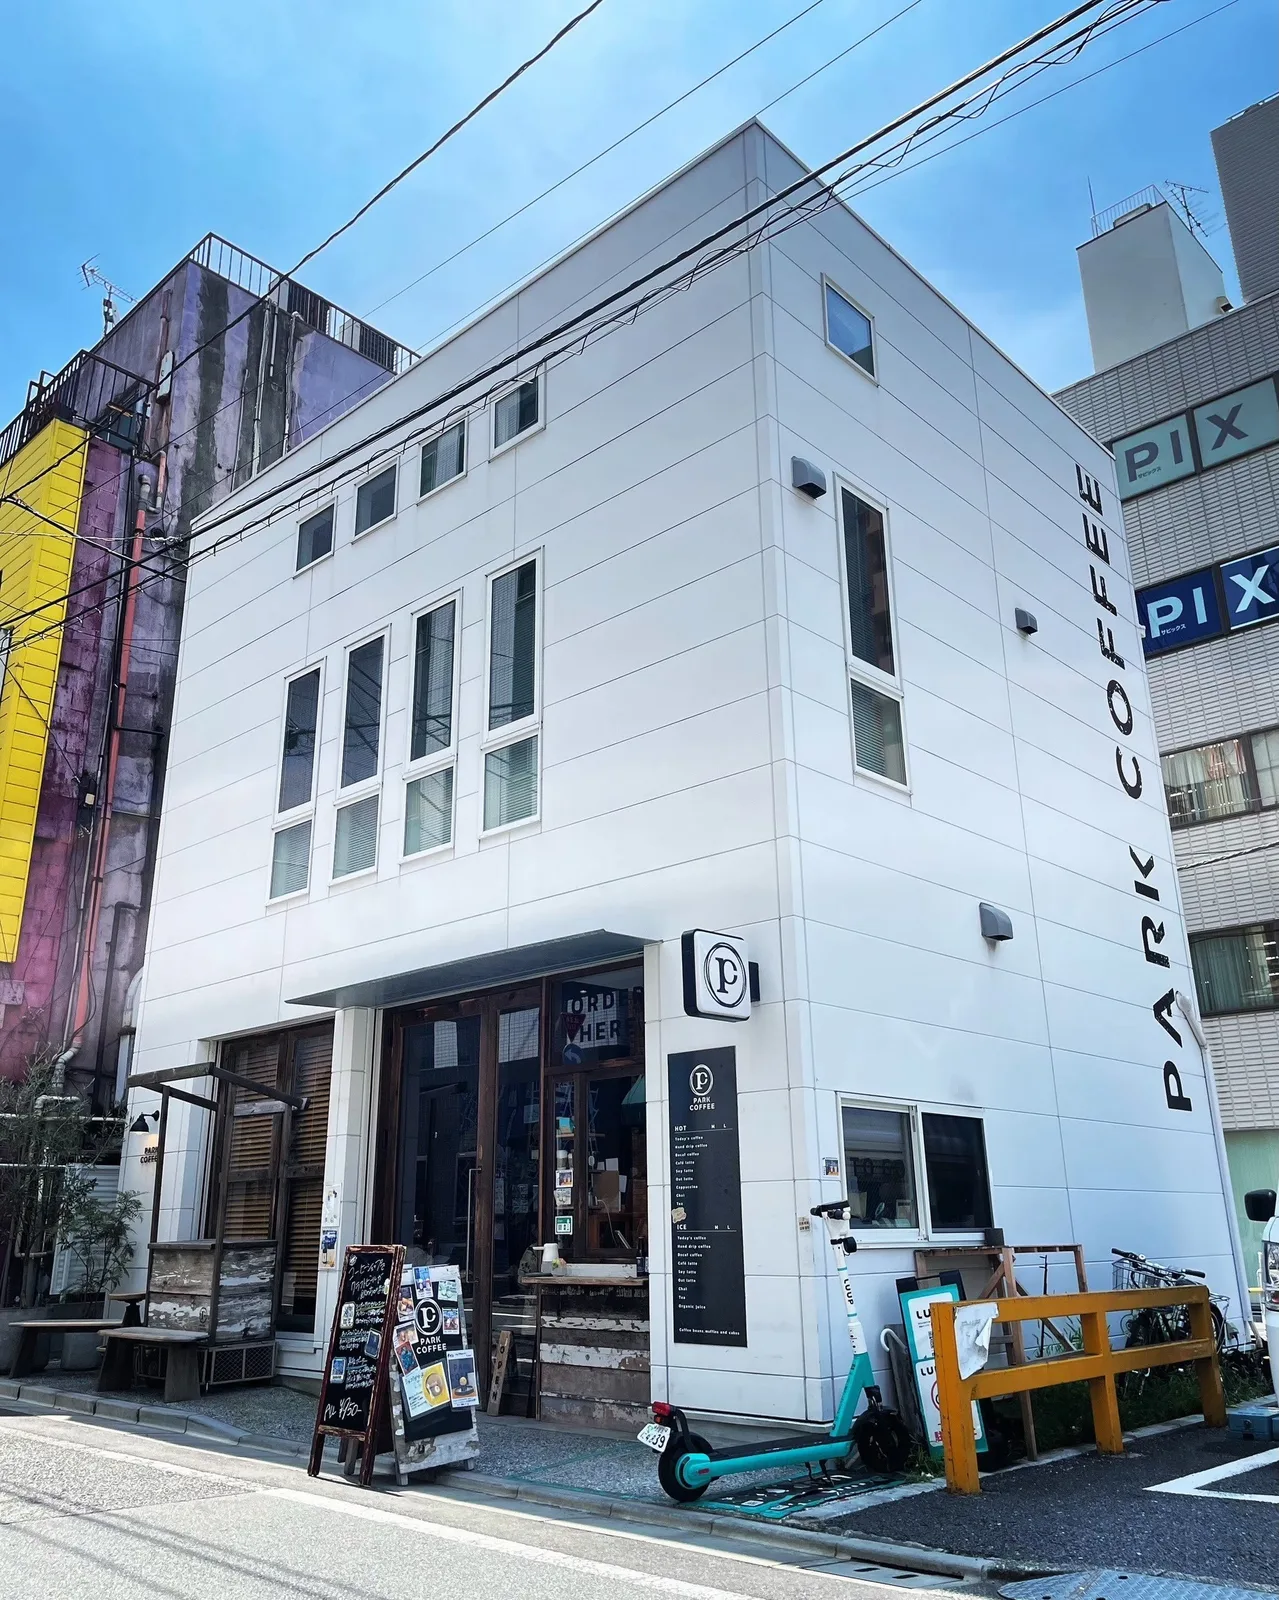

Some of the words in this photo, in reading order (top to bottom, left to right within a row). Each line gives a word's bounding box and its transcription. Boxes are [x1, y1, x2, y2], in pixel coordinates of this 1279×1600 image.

[1075, 462, 1143, 800] COFFEE
[1129, 845, 1193, 1112] PARK
[689, 1102, 715, 1111] COFFEE
[843, 1278, 854, 1305] LUUP
[916, 1309, 931, 1319] LU
[420, 1336, 441, 1345] PARK
[416, 1343, 447, 1354] COFFEE
[920, 1366, 934, 1376] LU
